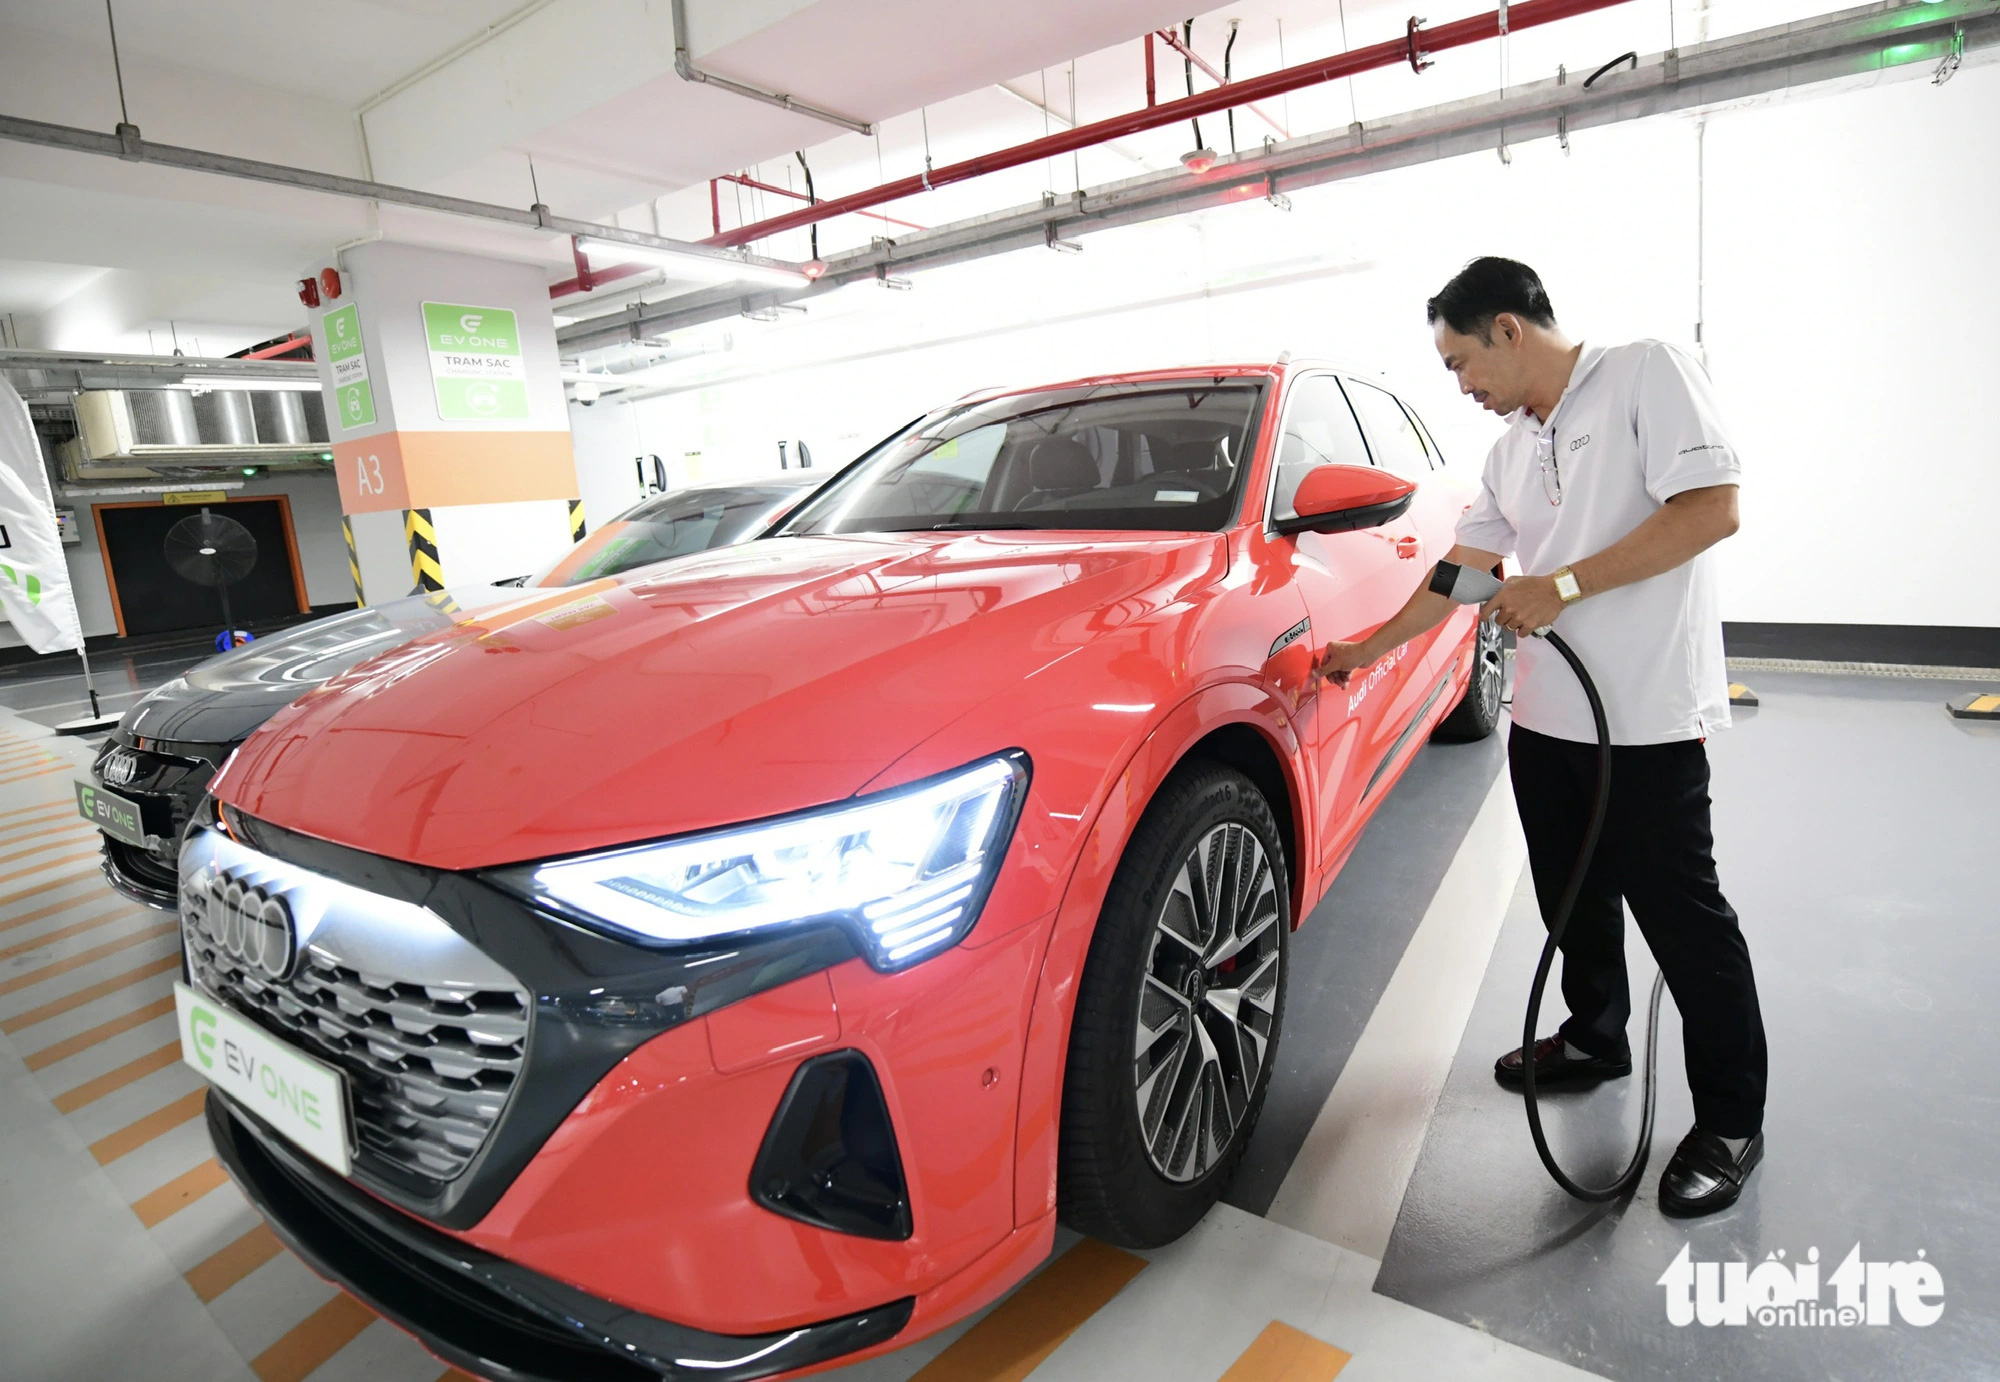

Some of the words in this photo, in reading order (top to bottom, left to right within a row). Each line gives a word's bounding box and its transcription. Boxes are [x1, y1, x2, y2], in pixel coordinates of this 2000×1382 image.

[331, 343, 341, 354] EV
[342, 337, 357, 351] ONE
[440, 334, 466, 345] EV
[469, 336, 508, 348] ONE
[357, 455, 385, 496] A3
[1347, 679, 1367, 718] Audi
[1368, 648, 1396, 690] Official
[1396, 641, 1409, 661] Car
[1225, 784, 1232, 801] 6
[96, 800, 111, 819] EV
[111, 806, 135, 832] ONE
[223, 1038, 255, 1082] EV
[260, 1064, 322, 1131] ONE
